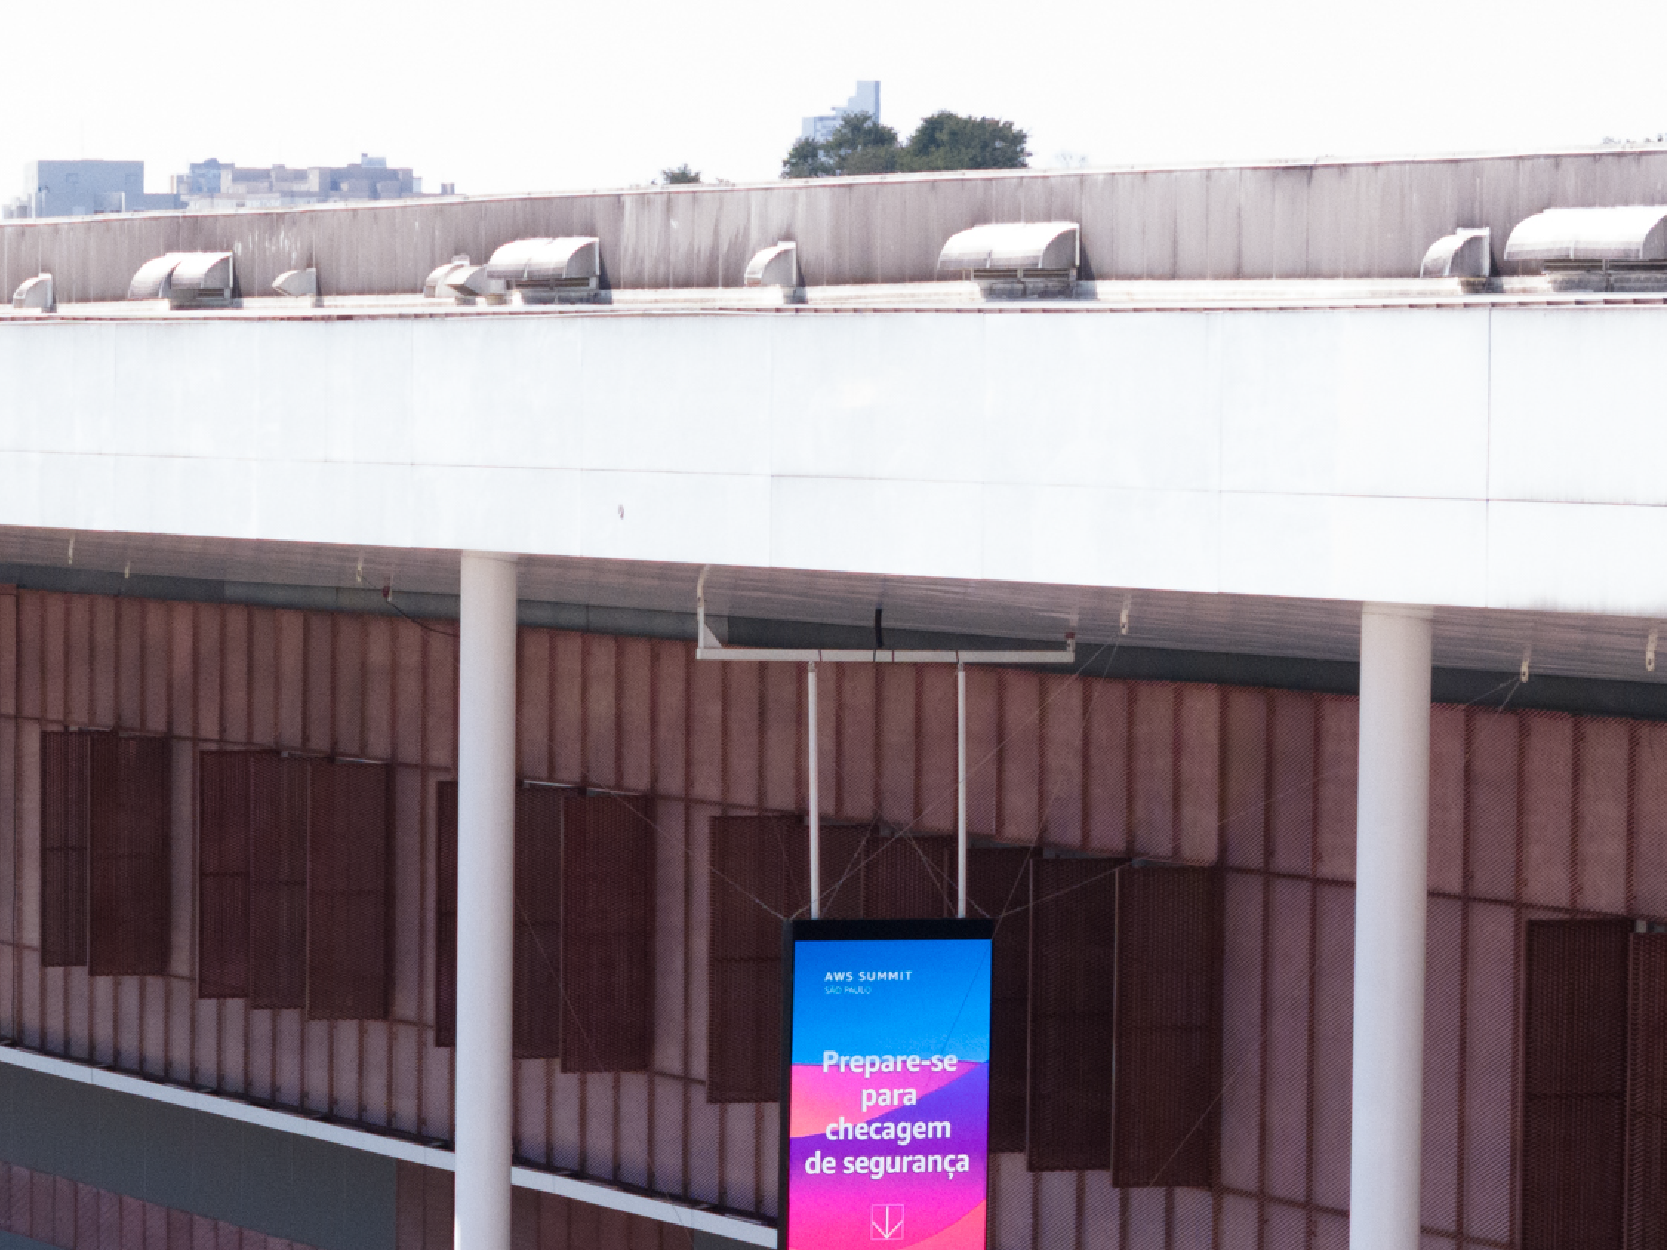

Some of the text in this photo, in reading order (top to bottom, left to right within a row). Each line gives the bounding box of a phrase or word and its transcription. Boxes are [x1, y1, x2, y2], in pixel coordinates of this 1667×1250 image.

[824, 970, 913, 982] AWS SUMMIT
[823, 1050, 958, 1079] Prepare-se
[861, 1088, 917, 1112] para
[825, 1116, 951, 1146] checagem
[804, 1150, 970, 1180] de segurança
